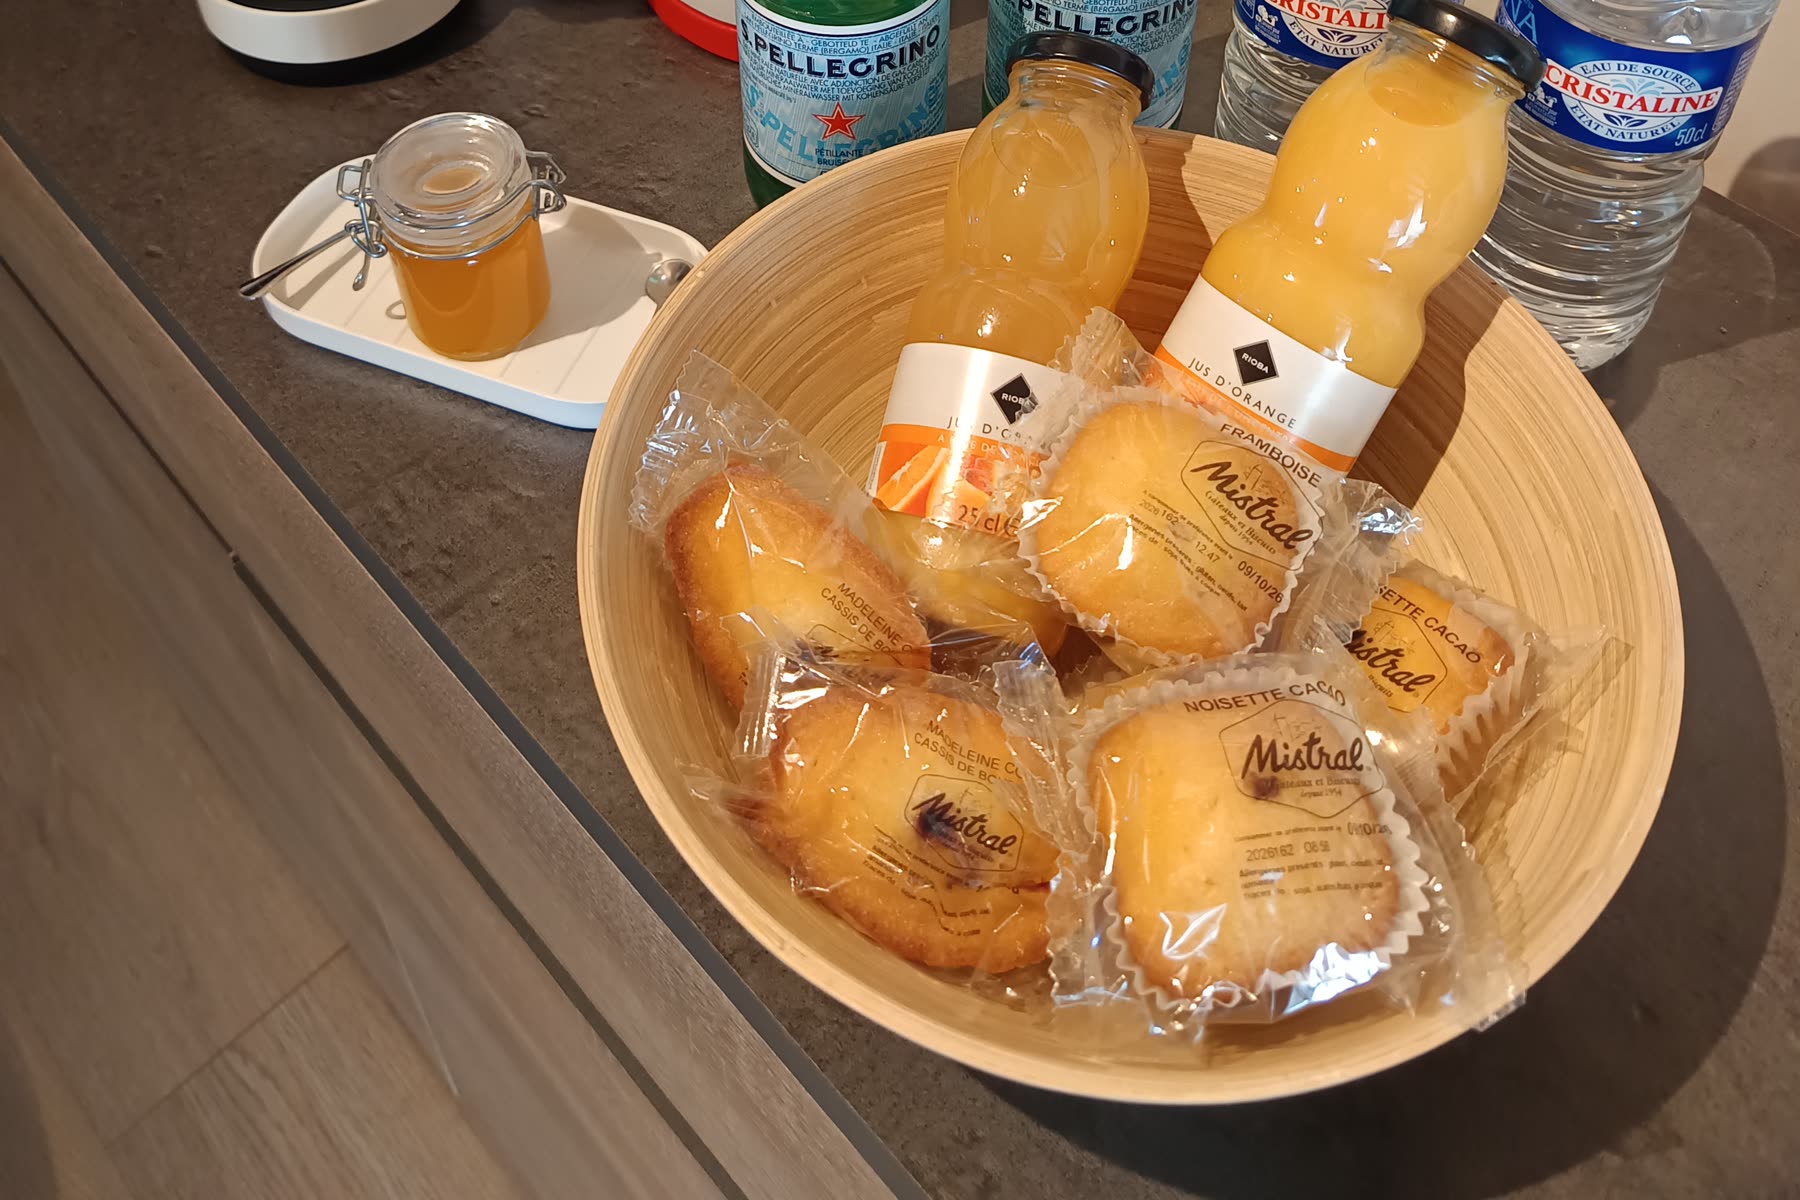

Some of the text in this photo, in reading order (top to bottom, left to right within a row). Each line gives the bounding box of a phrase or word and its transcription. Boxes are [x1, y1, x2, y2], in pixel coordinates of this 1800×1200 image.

[741, 18, 940, 79] S.PELLEGRINO
[1289, 20, 1319, 47] ETAT
[1321, 36, 1384, 55] NATURE
[1545, 64, 1719, 114] CRISTALINE
[1580, 63, 1697, 92] EAU DE SOURCE
[1569, 104, 1605, 132] ETAT
[1605, 120, 1681, 140] NATUREL
[1674, 123, 1708, 147] 50cl
[1241, 352, 1270, 374] RIOBA
[1188, 357, 1211, 377] JUS
[1215, 375, 1297, 429] D'ORANGE
[1220, 423, 1322, 488] FRAMBOISE
[1190, 461, 1314, 550] Mistral
[1237, 560, 1284, 604] 09/10/26
[821, 587, 860, 626] CASSIS
[857, 622, 876, 642] DE
[837, 582, 903, 646] MADELEINE
[1423, 616, 1482, 665] CACAO
[1183, 680, 1347, 713] NOISETTE CACAO
[914, 732, 955, 766] CASSIS
[957, 762, 976, 776] DE
[926, 720, 1001, 771] MADELEINE
[1240, 731, 1365, 780] Mistral
[911, 792, 1017, 855] Mistral
